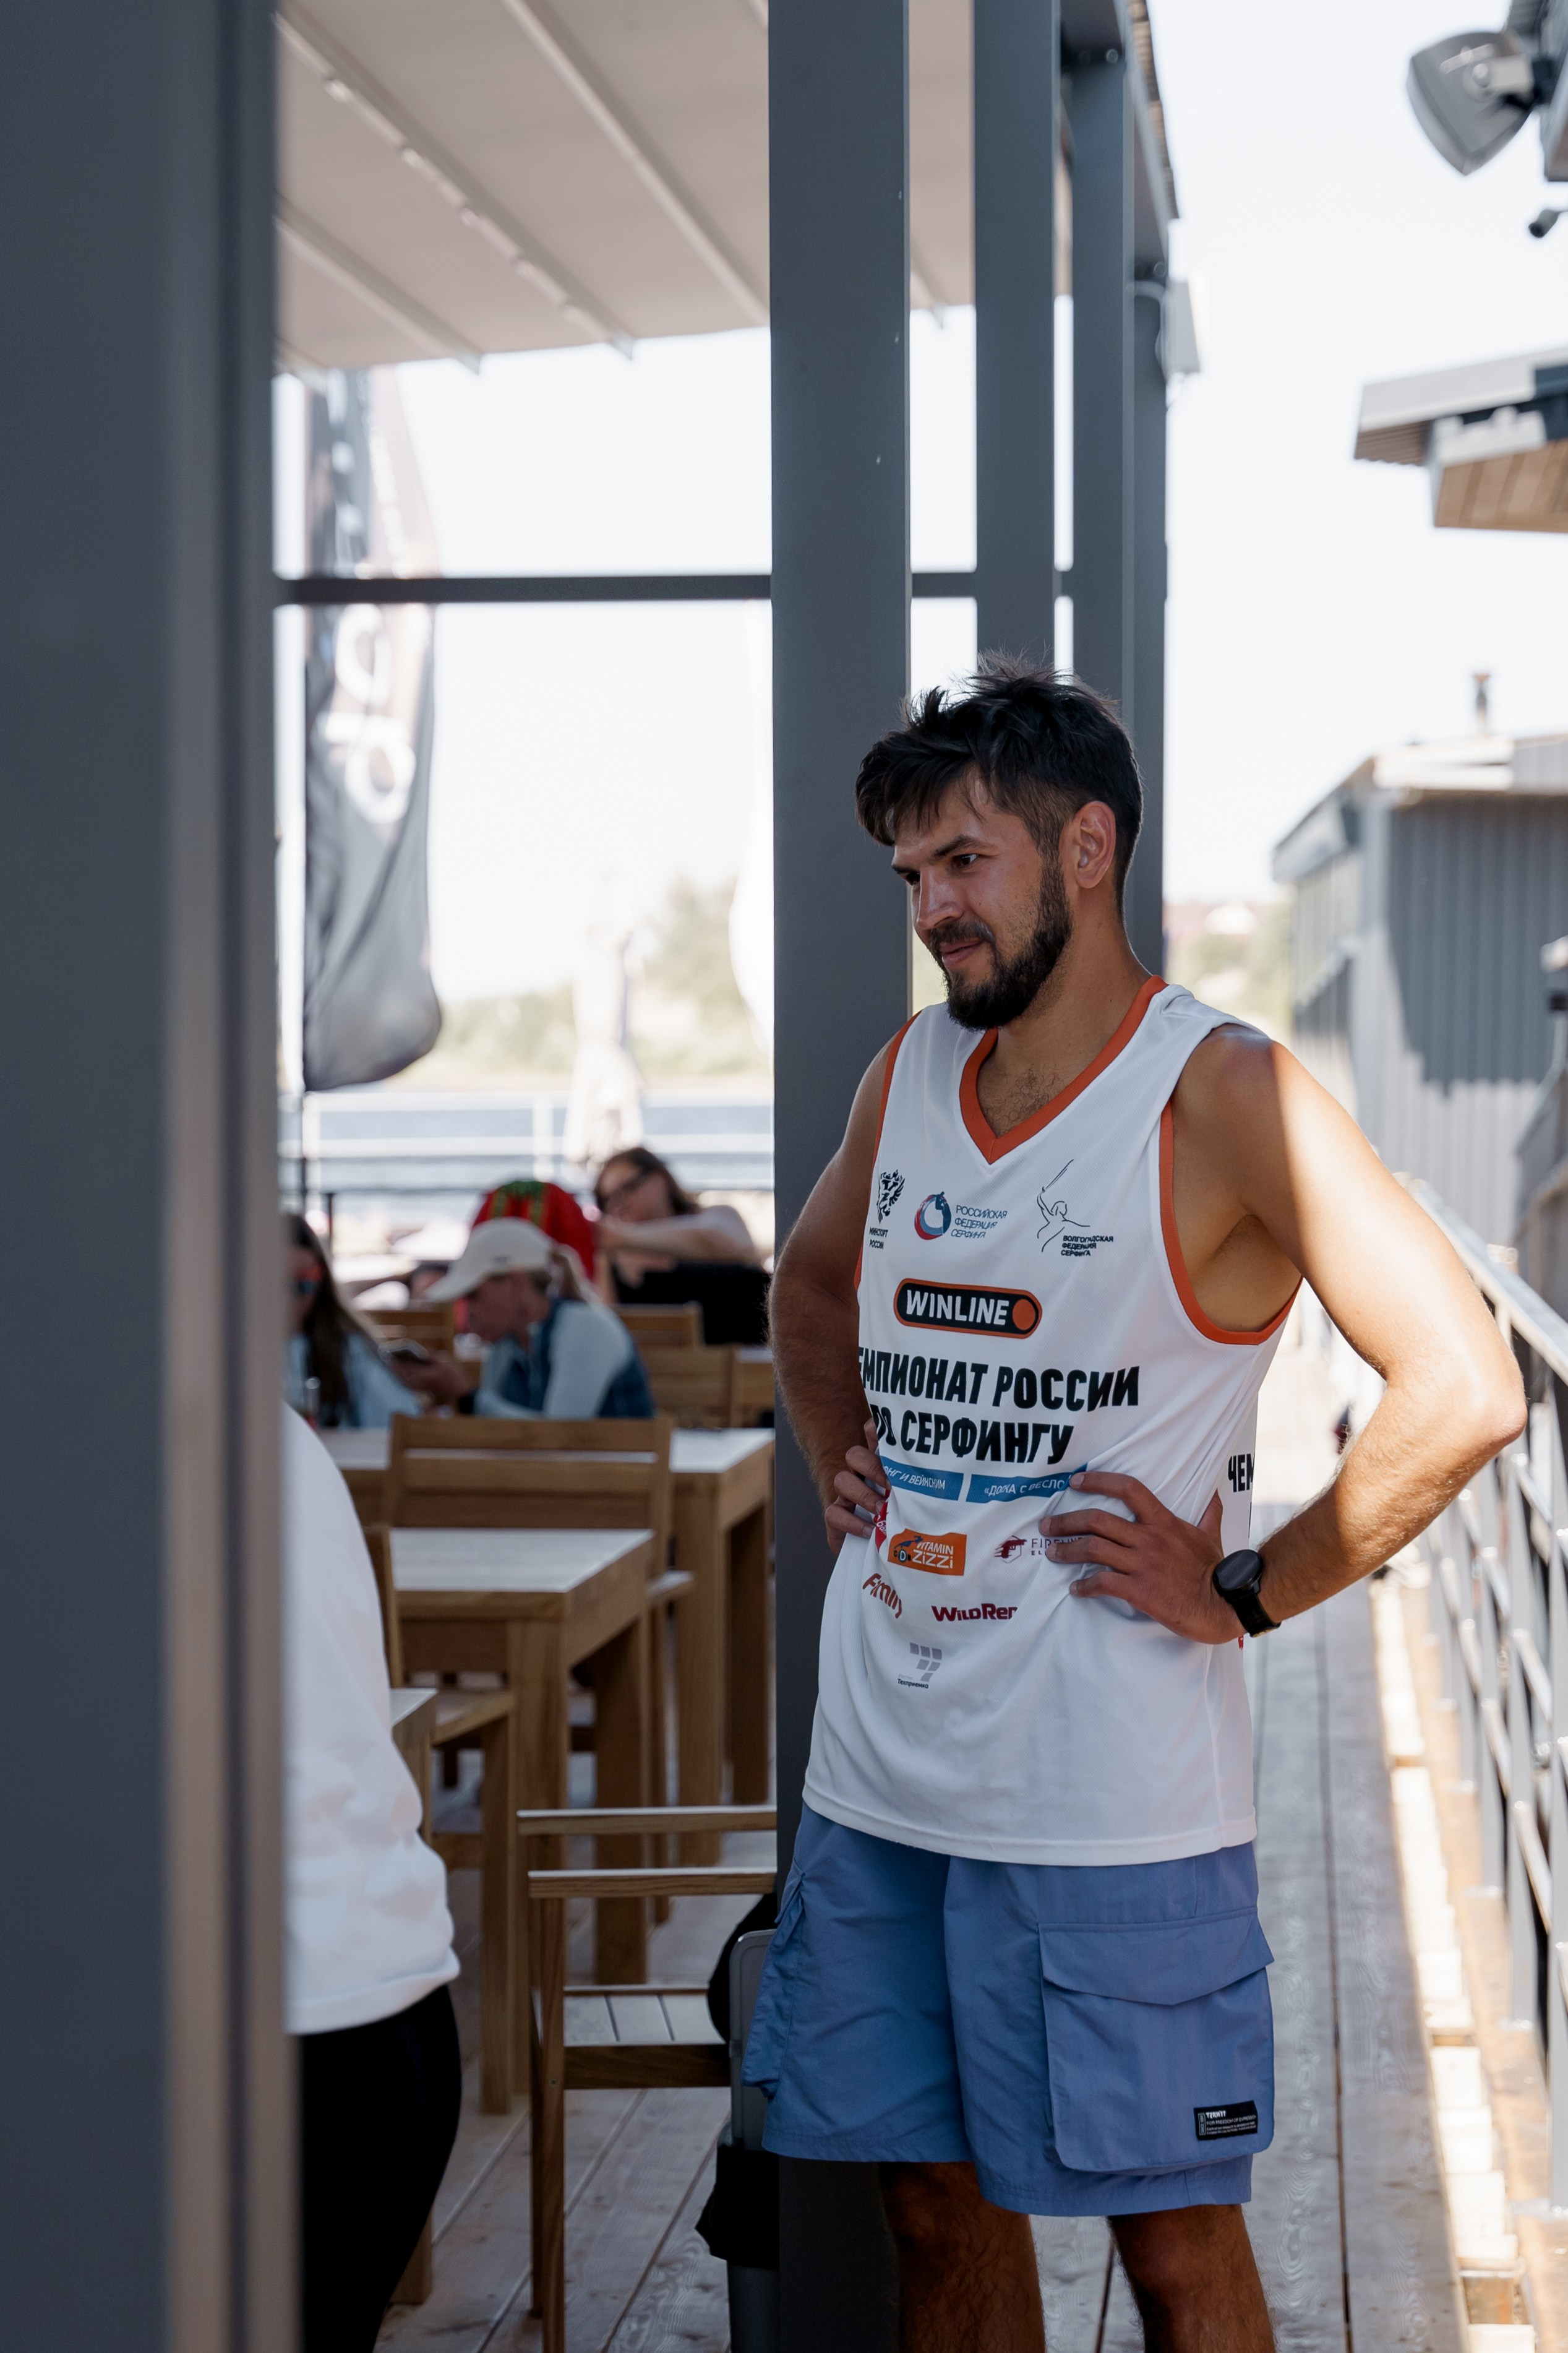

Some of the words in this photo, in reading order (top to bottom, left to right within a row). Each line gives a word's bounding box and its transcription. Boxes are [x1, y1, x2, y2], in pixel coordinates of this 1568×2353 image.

[956, 1205, 1008, 1219] РОССИЙСКАЯ
[954, 1217, 998, 1229] ФЕДЕРАЦИЯ
[906, 1289, 1009, 1325] WINLINE
[992, 1366, 1140, 1412] РОССИИ
[901, 1409, 1074, 1465] СЕРФИНГУ
[899, 1473, 909, 1481] И
[1020, 1485, 1027, 1493] С
